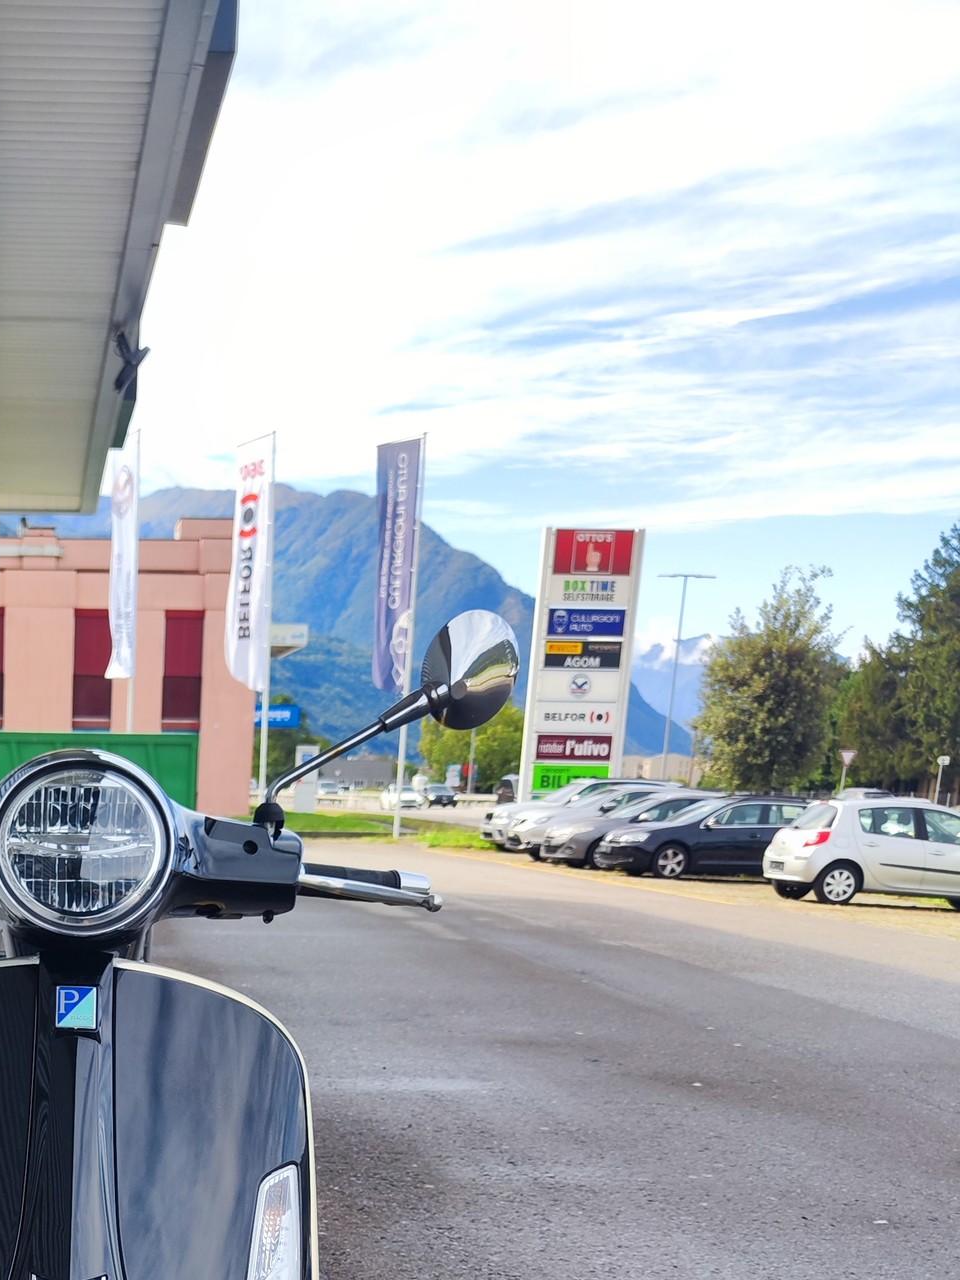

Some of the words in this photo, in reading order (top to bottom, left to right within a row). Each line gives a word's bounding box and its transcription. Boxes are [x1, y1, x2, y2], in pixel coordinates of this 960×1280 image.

[576, 533, 614, 543] OTTO'S
[564, 580, 587, 592] BOX
[590, 580, 616, 592] TIME
[562, 593, 614, 602] SELFSTORAGE
[569, 623, 593, 632] AUTO
[563, 656, 600, 667] AGOM
[544, 712, 586, 722] BELFOR
[59, 989, 80, 1014] P
